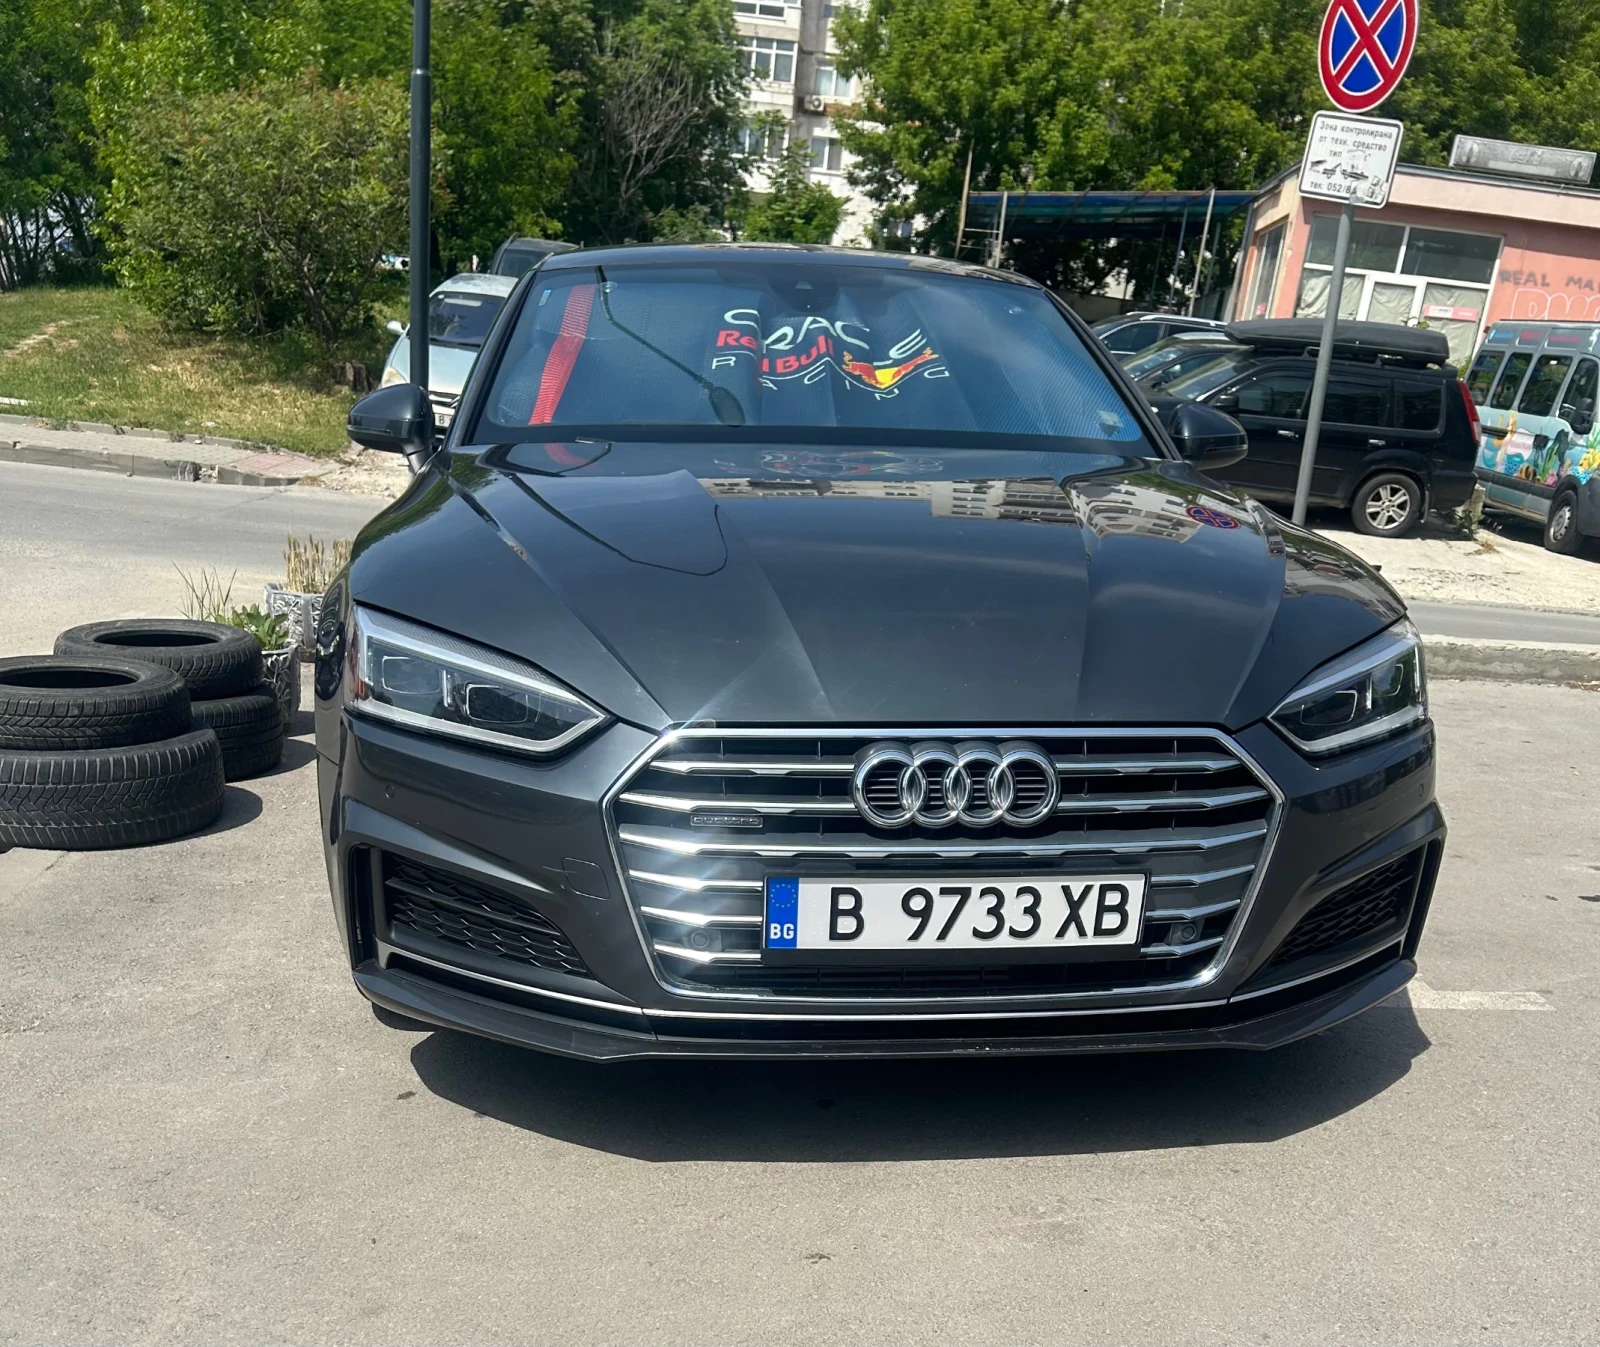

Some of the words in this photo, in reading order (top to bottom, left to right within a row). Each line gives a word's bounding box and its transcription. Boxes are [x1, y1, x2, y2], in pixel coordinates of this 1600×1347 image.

[1319, 120, 1338, 131] Зона
[1341, 125, 1393, 139] контролирана
[1352, 140, 1388, 151] средство
[1499, 269, 1550, 287] REAL
[1565, 276, 1600, 293] MA
[829, 886, 865, 942] B
[901, 885, 1042, 942] 9733
[1054, 883, 1130, 940] XB
[770, 923, 795, 939] BG
